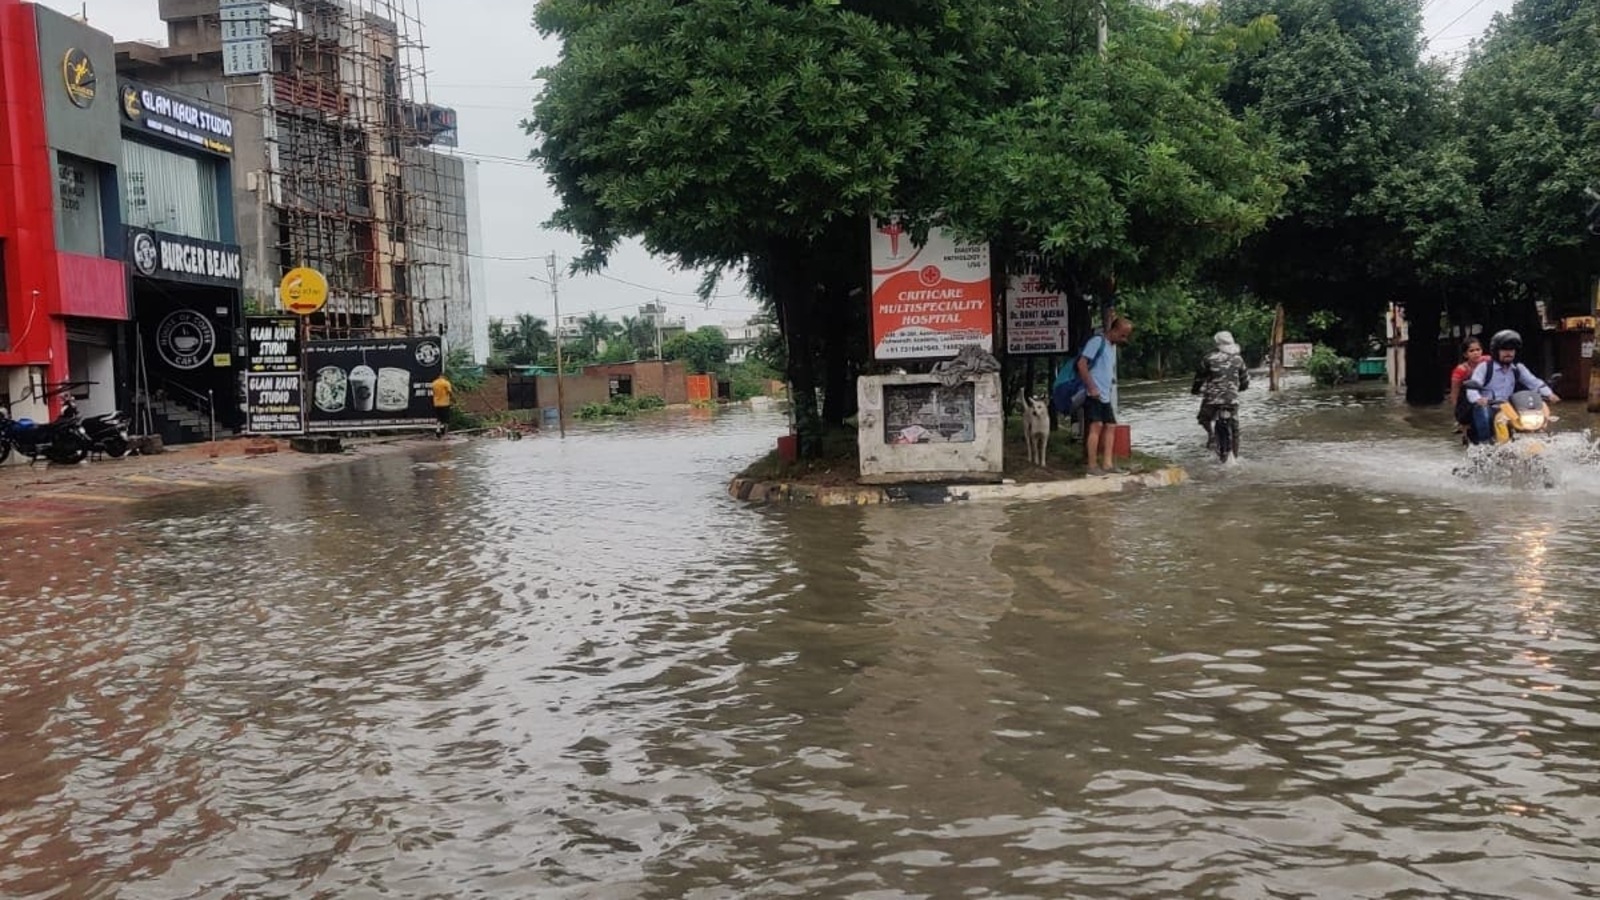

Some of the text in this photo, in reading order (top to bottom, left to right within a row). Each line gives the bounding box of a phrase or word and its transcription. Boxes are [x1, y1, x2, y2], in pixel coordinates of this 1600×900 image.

[142, 90, 172, 117] GLAM
[172, 100, 199, 129] KAUR
[199, 111, 232, 137] STUDIO
[160, 241, 240, 280] BURGER BEANS
[898, 288, 964, 301] CRITICARE
[1014, 295, 1059, 309] अस्पताल
[879, 299, 985, 314] MULTISPECIALITY
[901, 312, 962, 325] HOSPITAL
[250, 326, 296, 342] GLAM KAUR
[259, 341, 288, 356] STUDIO
[175, 355, 199, 366] CAFE
[249, 376, 298, 391] GLAM KAUR
[258, 390, 290, 405] STUDIO
